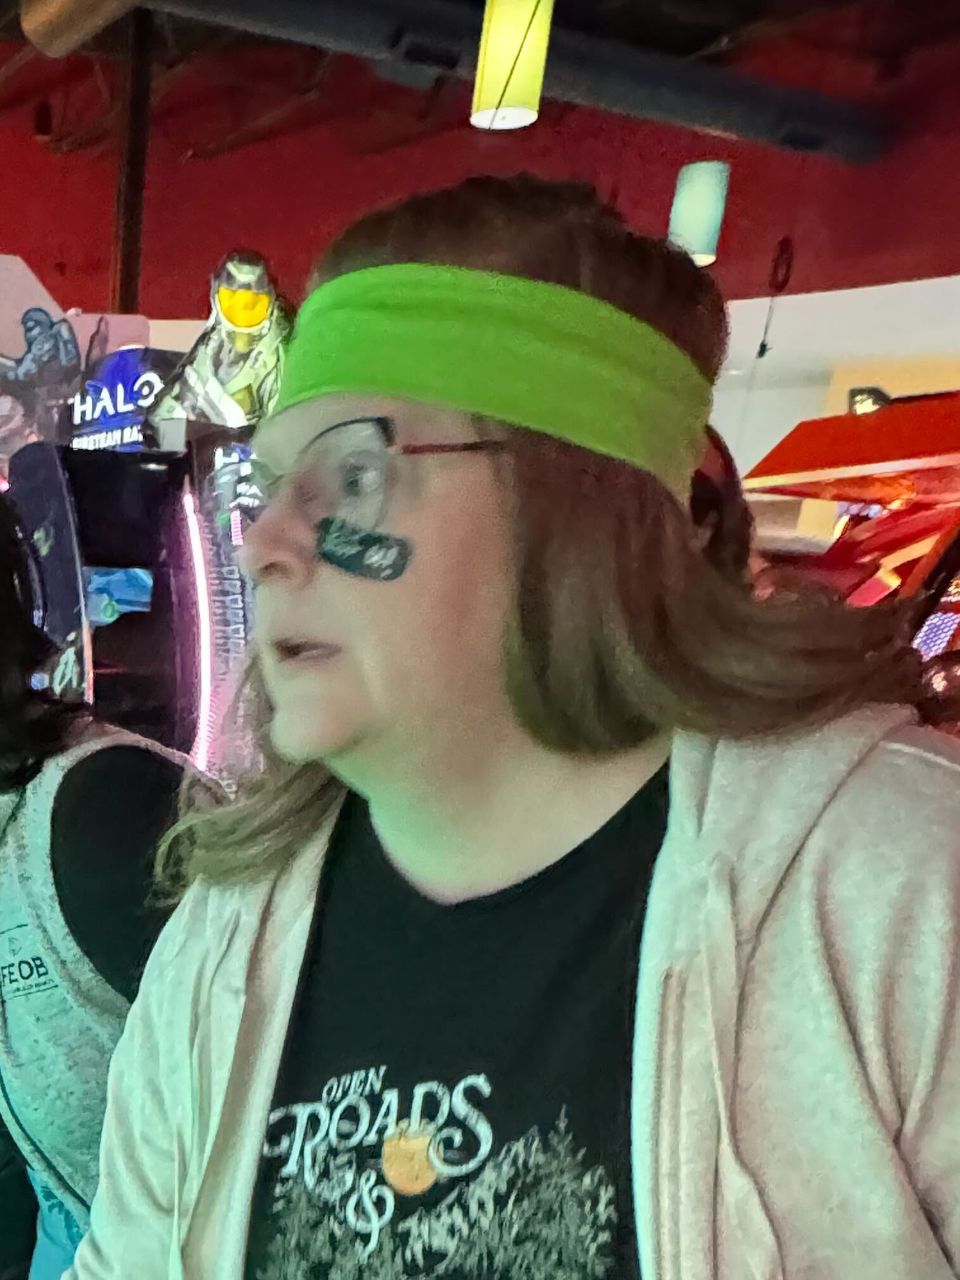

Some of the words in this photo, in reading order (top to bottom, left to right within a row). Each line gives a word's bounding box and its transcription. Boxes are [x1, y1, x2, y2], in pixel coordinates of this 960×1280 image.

[70, 371, 164, 425] HALO
[321, 1065, 387, 1103] OPEN
[263, 1072, 493, 1191] ROADS
[345, 1169, 395, 1264] &
